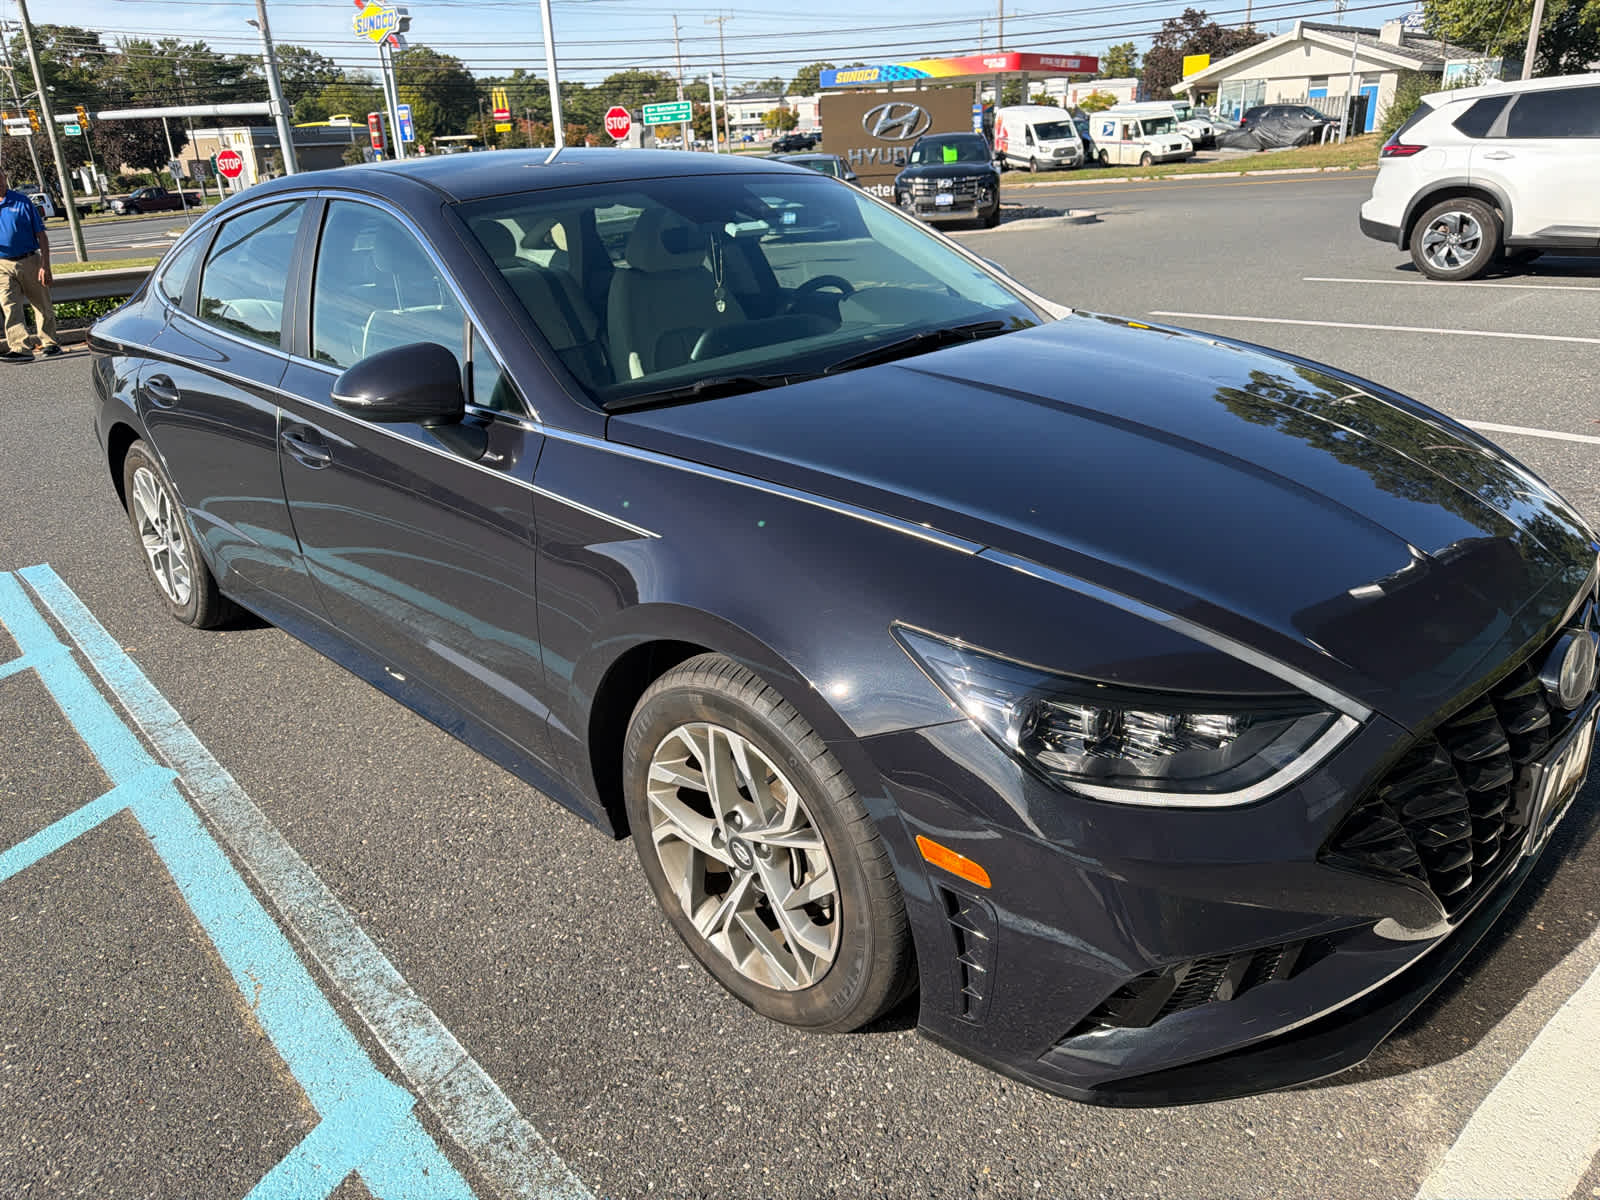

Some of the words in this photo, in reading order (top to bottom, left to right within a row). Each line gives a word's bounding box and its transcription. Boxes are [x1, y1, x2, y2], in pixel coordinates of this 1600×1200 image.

[357, 12, 393, 33] SUNOCO
[836, 67, 879, 83] SUNOCO
[607, 116, 629, 130] STOP
[219, 158, 241, 171] STOP
